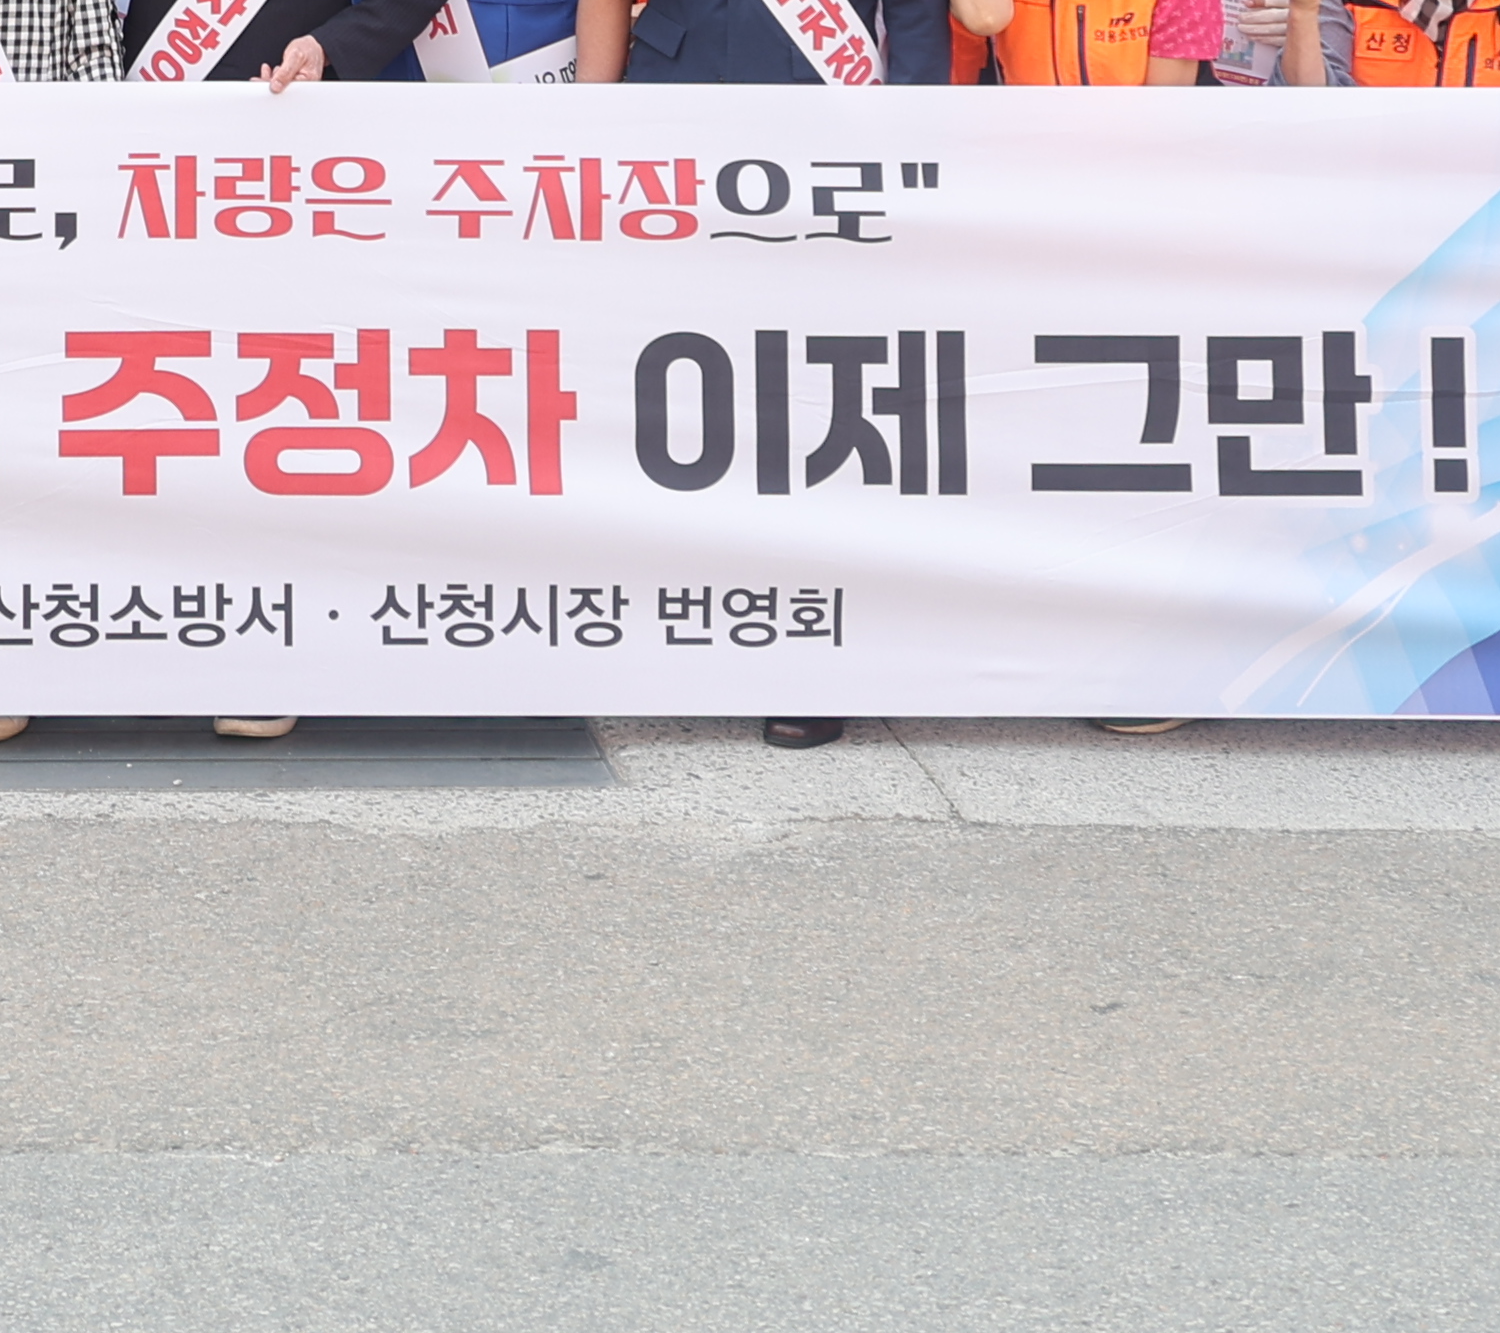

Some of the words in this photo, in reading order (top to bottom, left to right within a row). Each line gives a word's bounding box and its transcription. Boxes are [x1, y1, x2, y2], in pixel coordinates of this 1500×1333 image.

[117, 152, 392, 243] 차량은
[425, 155, 943, 245] 주차장으로"
[58, 329, 577, 497] 주정차
[634, 329, 968, 497] 이제
[371, 585, 629, 649] 산청시장
[658, 585, 846, 650] 번영회
